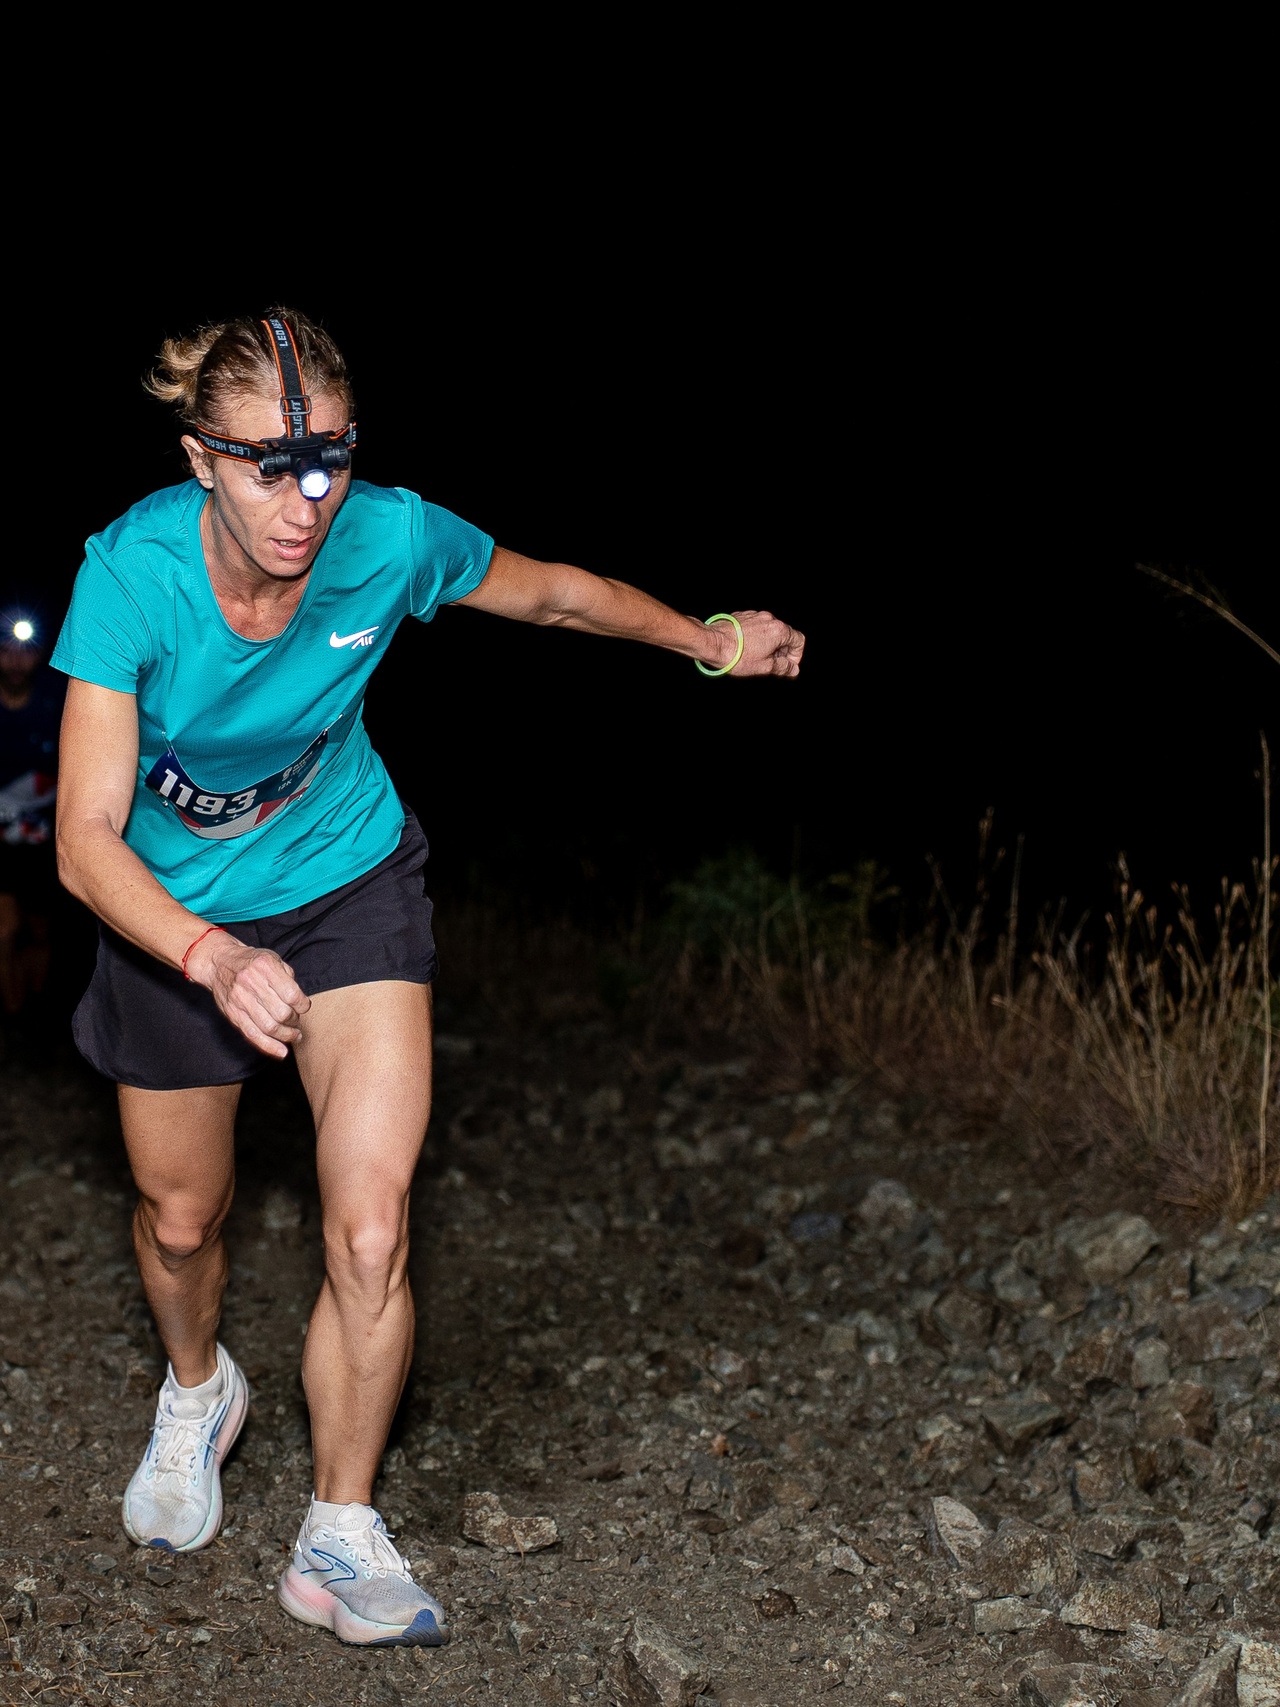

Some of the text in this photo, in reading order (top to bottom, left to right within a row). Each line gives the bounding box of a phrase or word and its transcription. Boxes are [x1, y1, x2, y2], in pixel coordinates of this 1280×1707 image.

[275, 330, 289, 347] LED
[228, 444, 251, 457] LED
[159, 768, 257, 815] 1193
